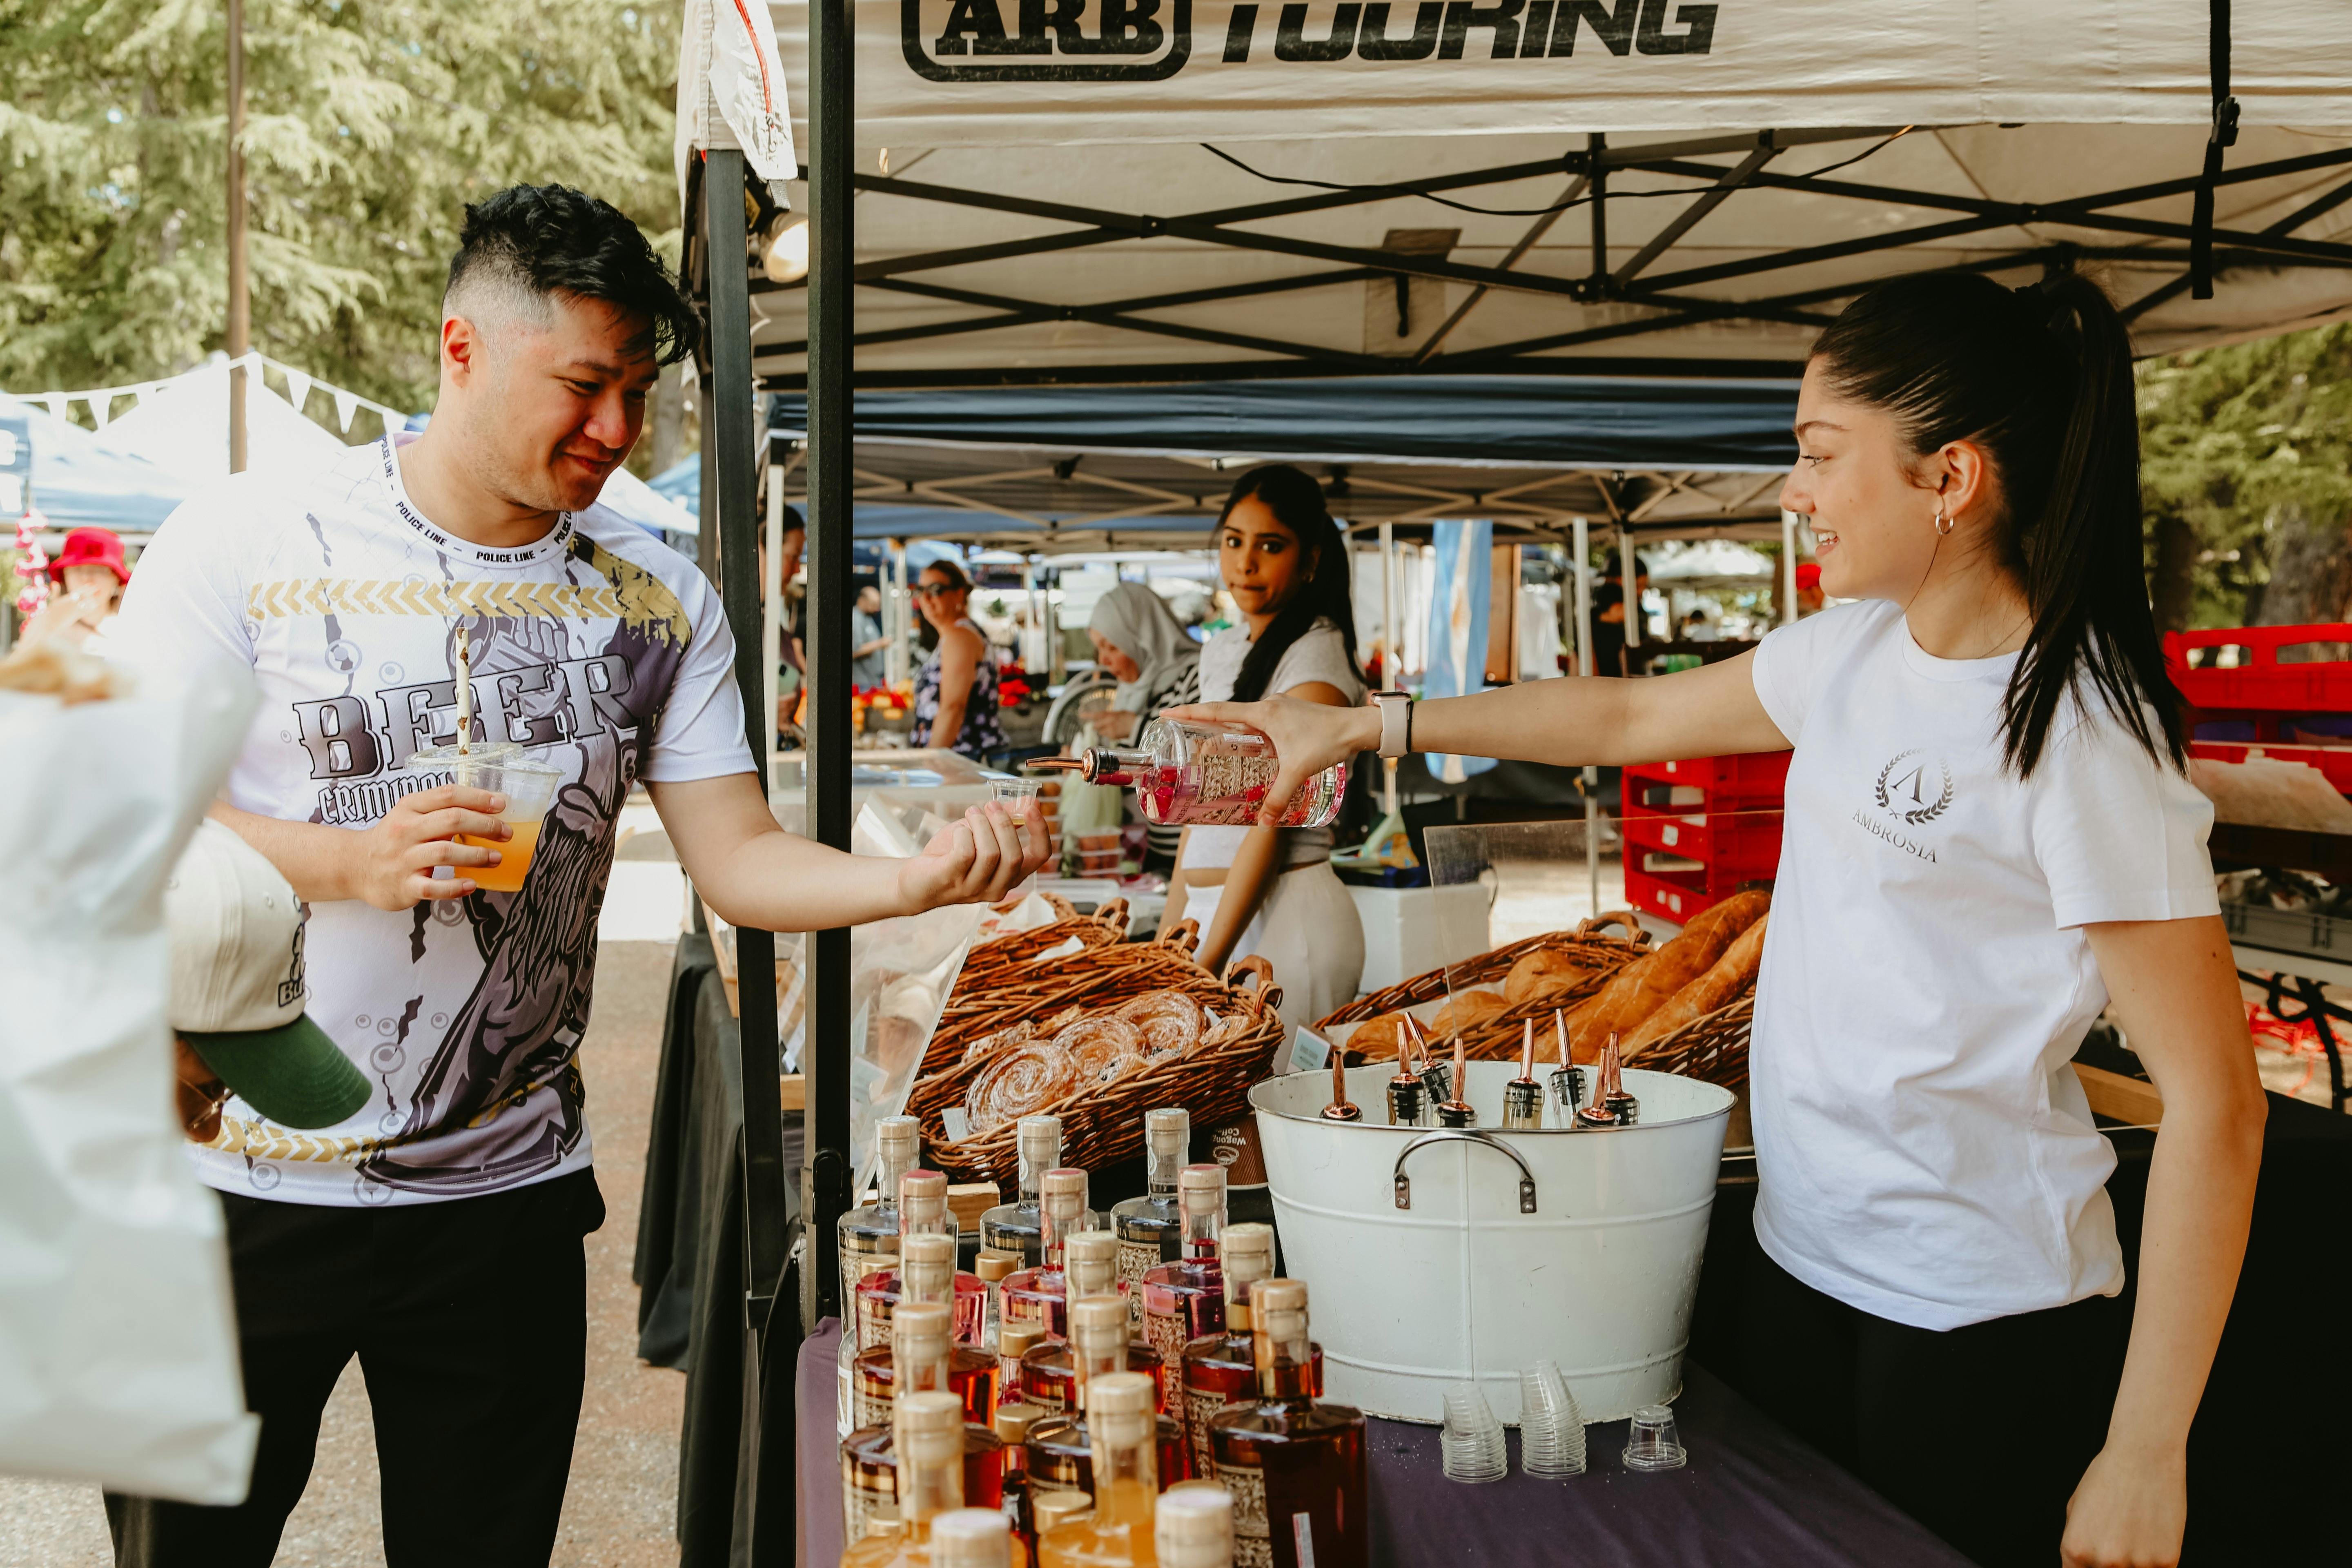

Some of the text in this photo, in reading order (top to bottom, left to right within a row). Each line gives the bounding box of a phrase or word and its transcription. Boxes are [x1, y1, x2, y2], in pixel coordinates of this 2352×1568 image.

[935, 0, 1719, 63] ARB TOURING
[396, 501, 447, 546] POLICE LINE
[476, 550, 535, 562] POLICE LINE
[292, 654, 644, 780] BEER
[1853, 809, 1937, 863] AMBROSIA
